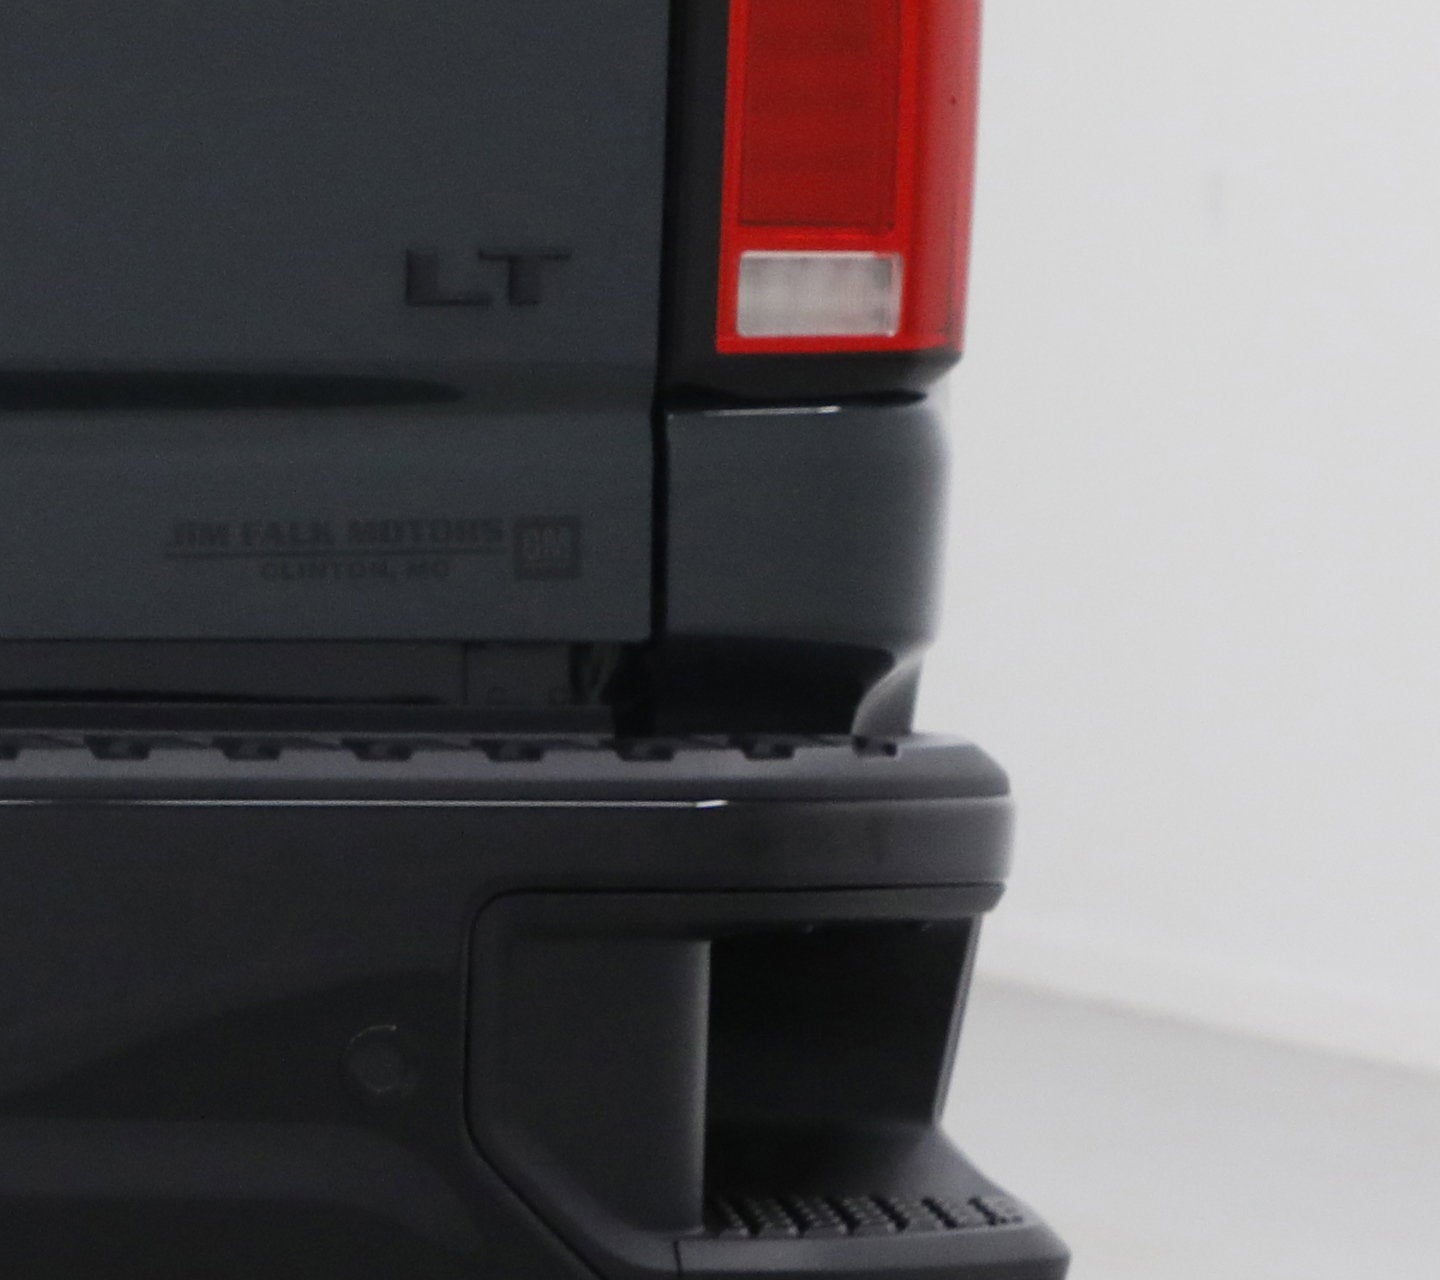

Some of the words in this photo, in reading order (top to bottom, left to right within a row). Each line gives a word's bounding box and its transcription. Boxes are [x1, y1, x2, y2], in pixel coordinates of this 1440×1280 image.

[402, 248, 573, 308] LT
[242, 521, 336, 546] FALK
[348, 518, 504, 545] MOTORS
